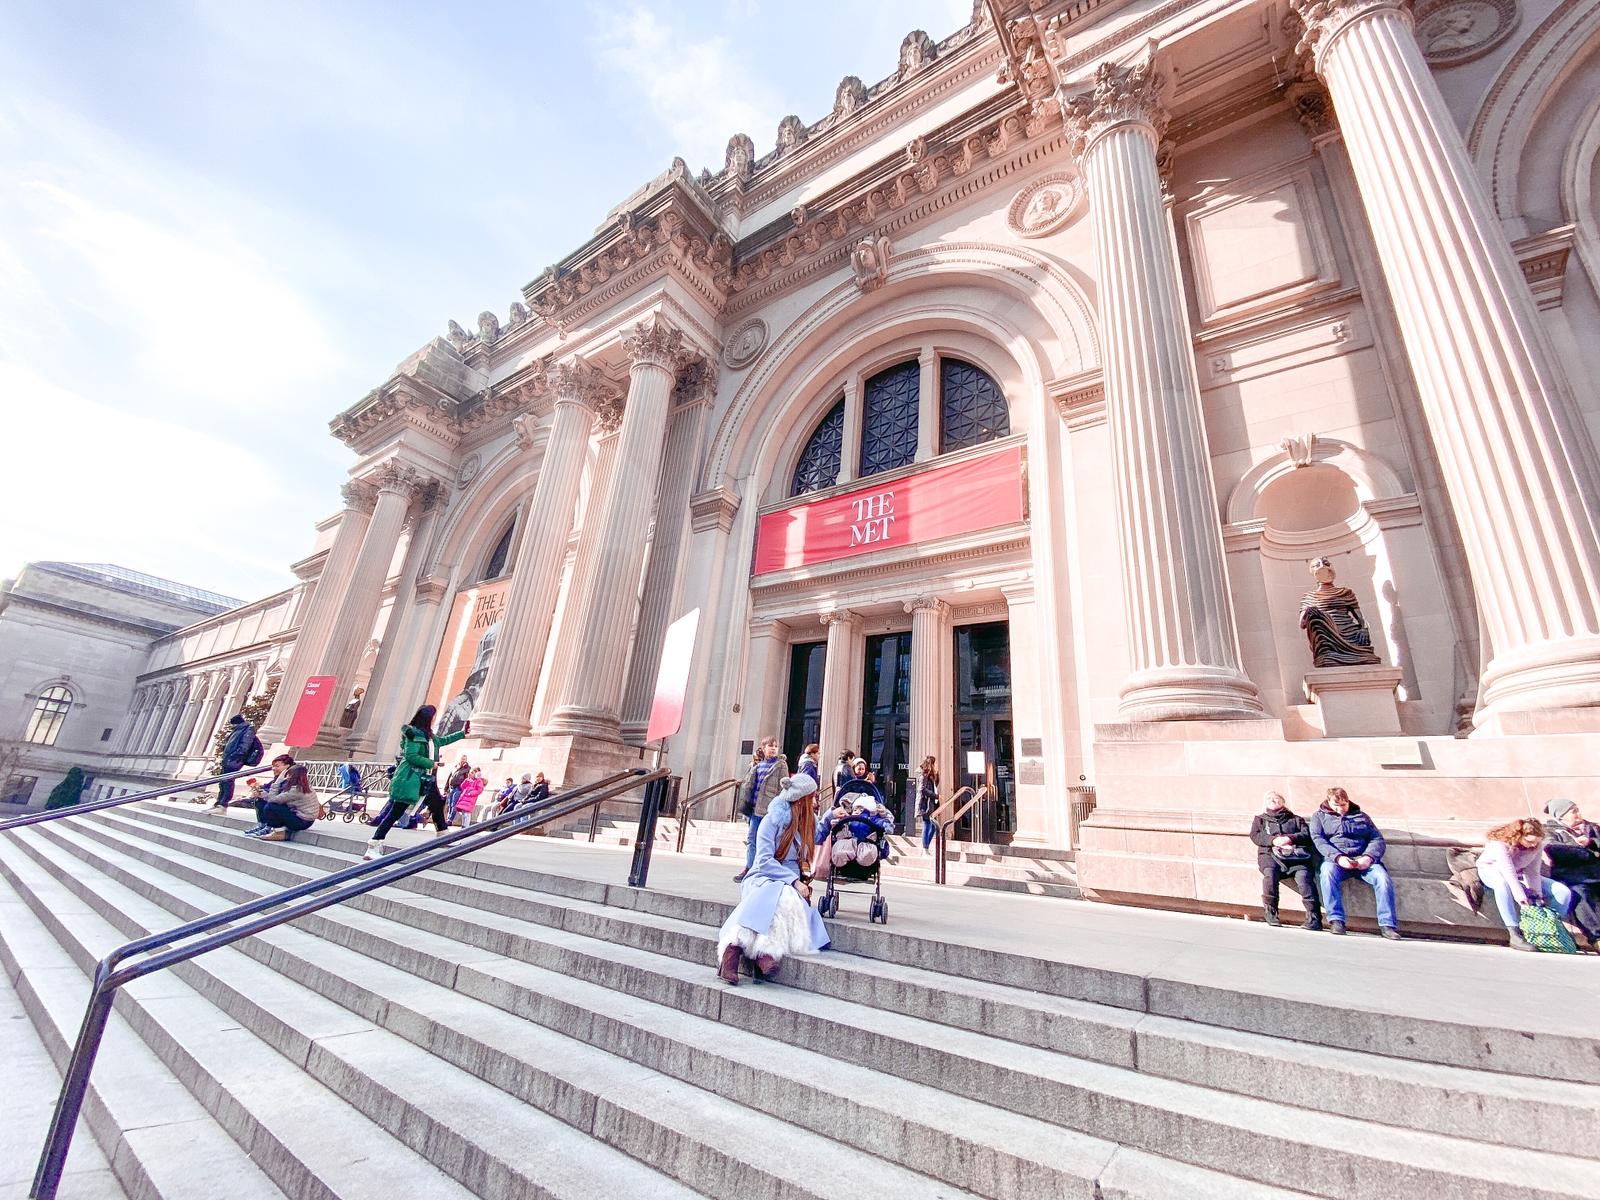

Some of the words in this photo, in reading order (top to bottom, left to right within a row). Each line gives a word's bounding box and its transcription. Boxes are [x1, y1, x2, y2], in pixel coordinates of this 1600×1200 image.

[852, 491, 895, 522] THE
[849, 515, 895, 547] MET
[477, 593, 497, 612] THE
